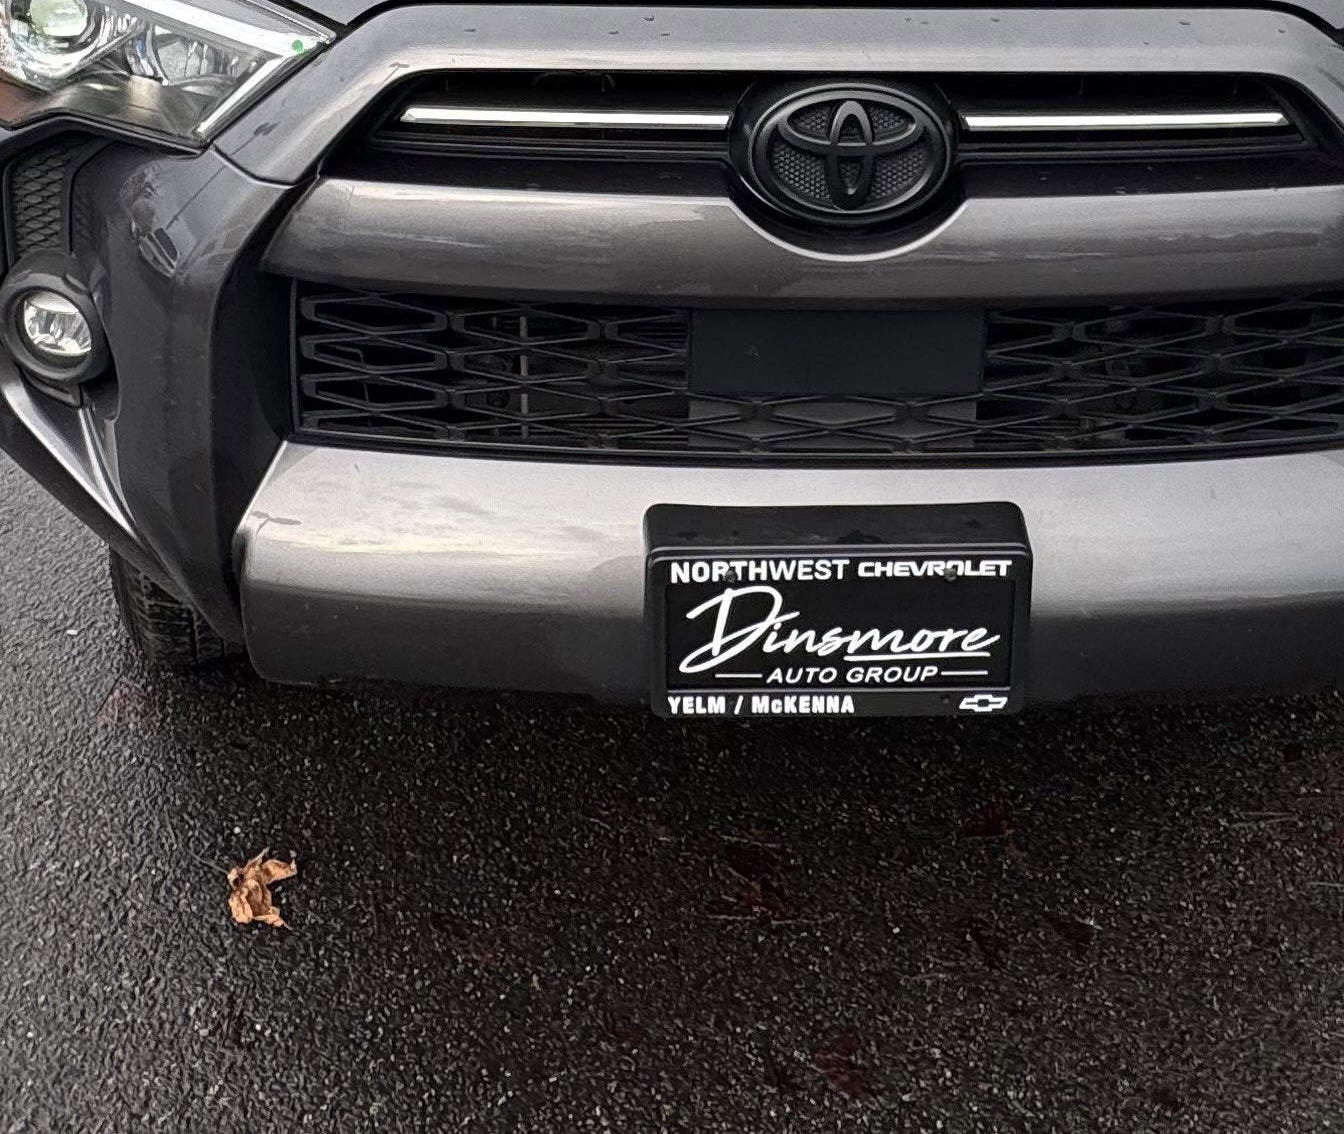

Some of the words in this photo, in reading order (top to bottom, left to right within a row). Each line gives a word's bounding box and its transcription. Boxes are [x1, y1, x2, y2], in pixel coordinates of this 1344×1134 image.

[670, 559, 850, 584] NORTHWEST
[857, 559, 1013, 577] CHEVROLET
[679, 585, 1001, 674] Dinsmore
[766, 668, 837, 684] AUTO
[846, 666, 938, 683] GROUP
[667, 696, 726, 715] YELM
[751, 695, 855, 714] McKENNA
